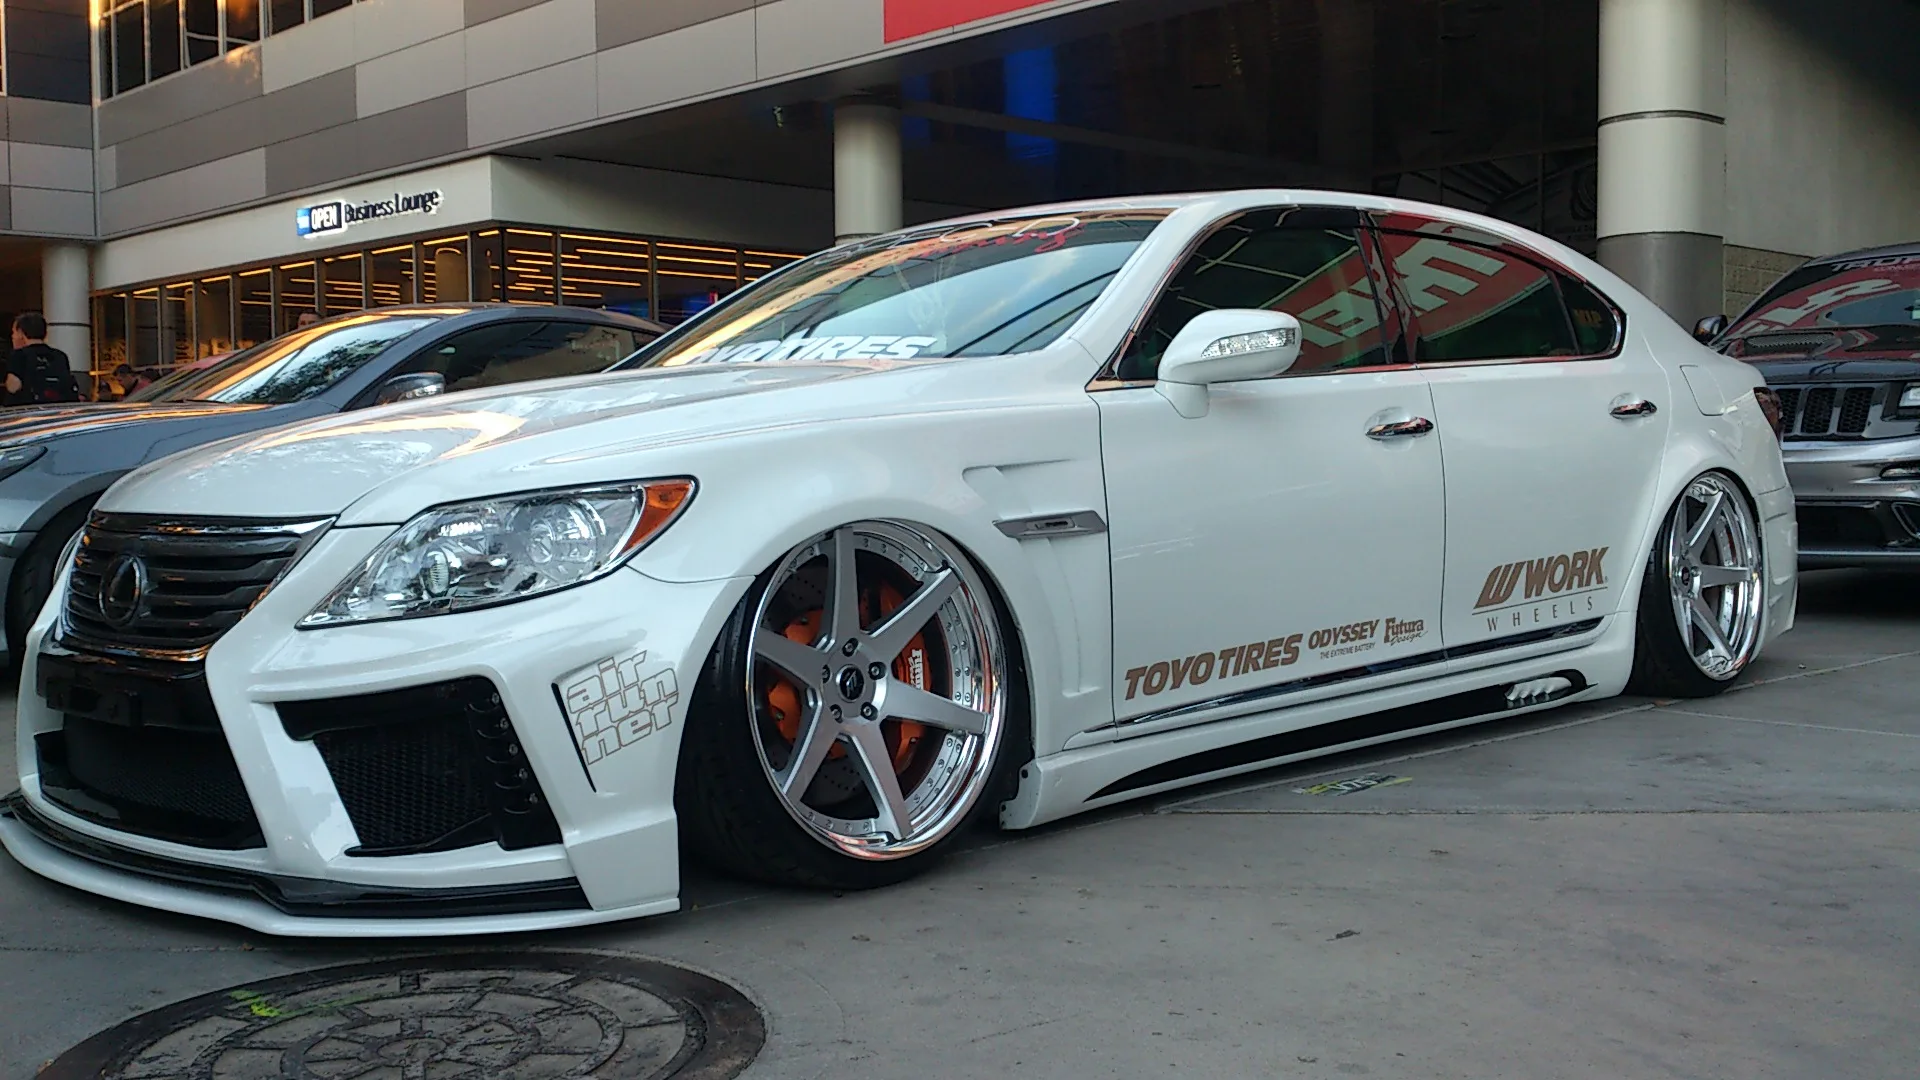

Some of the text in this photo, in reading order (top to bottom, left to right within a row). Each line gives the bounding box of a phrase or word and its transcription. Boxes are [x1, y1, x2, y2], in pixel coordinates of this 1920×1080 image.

[311, 191, 439, 230] OPEN Business Lounge
[765, 334, 938, 361] TIRES
[1524, 546, 1609, 599] WORK
[1487, 596, 1593, 632] WHEELS
[1125, 617, 1424, 701] TOYO TIRES ODYSSEY Futura
[1320, 641, 1377, 660] THE EXTREME BATTERY
[567, 650, 647, 714] air
[576, 668, 678, 739] run
[582, 692, 679, 765] ner
